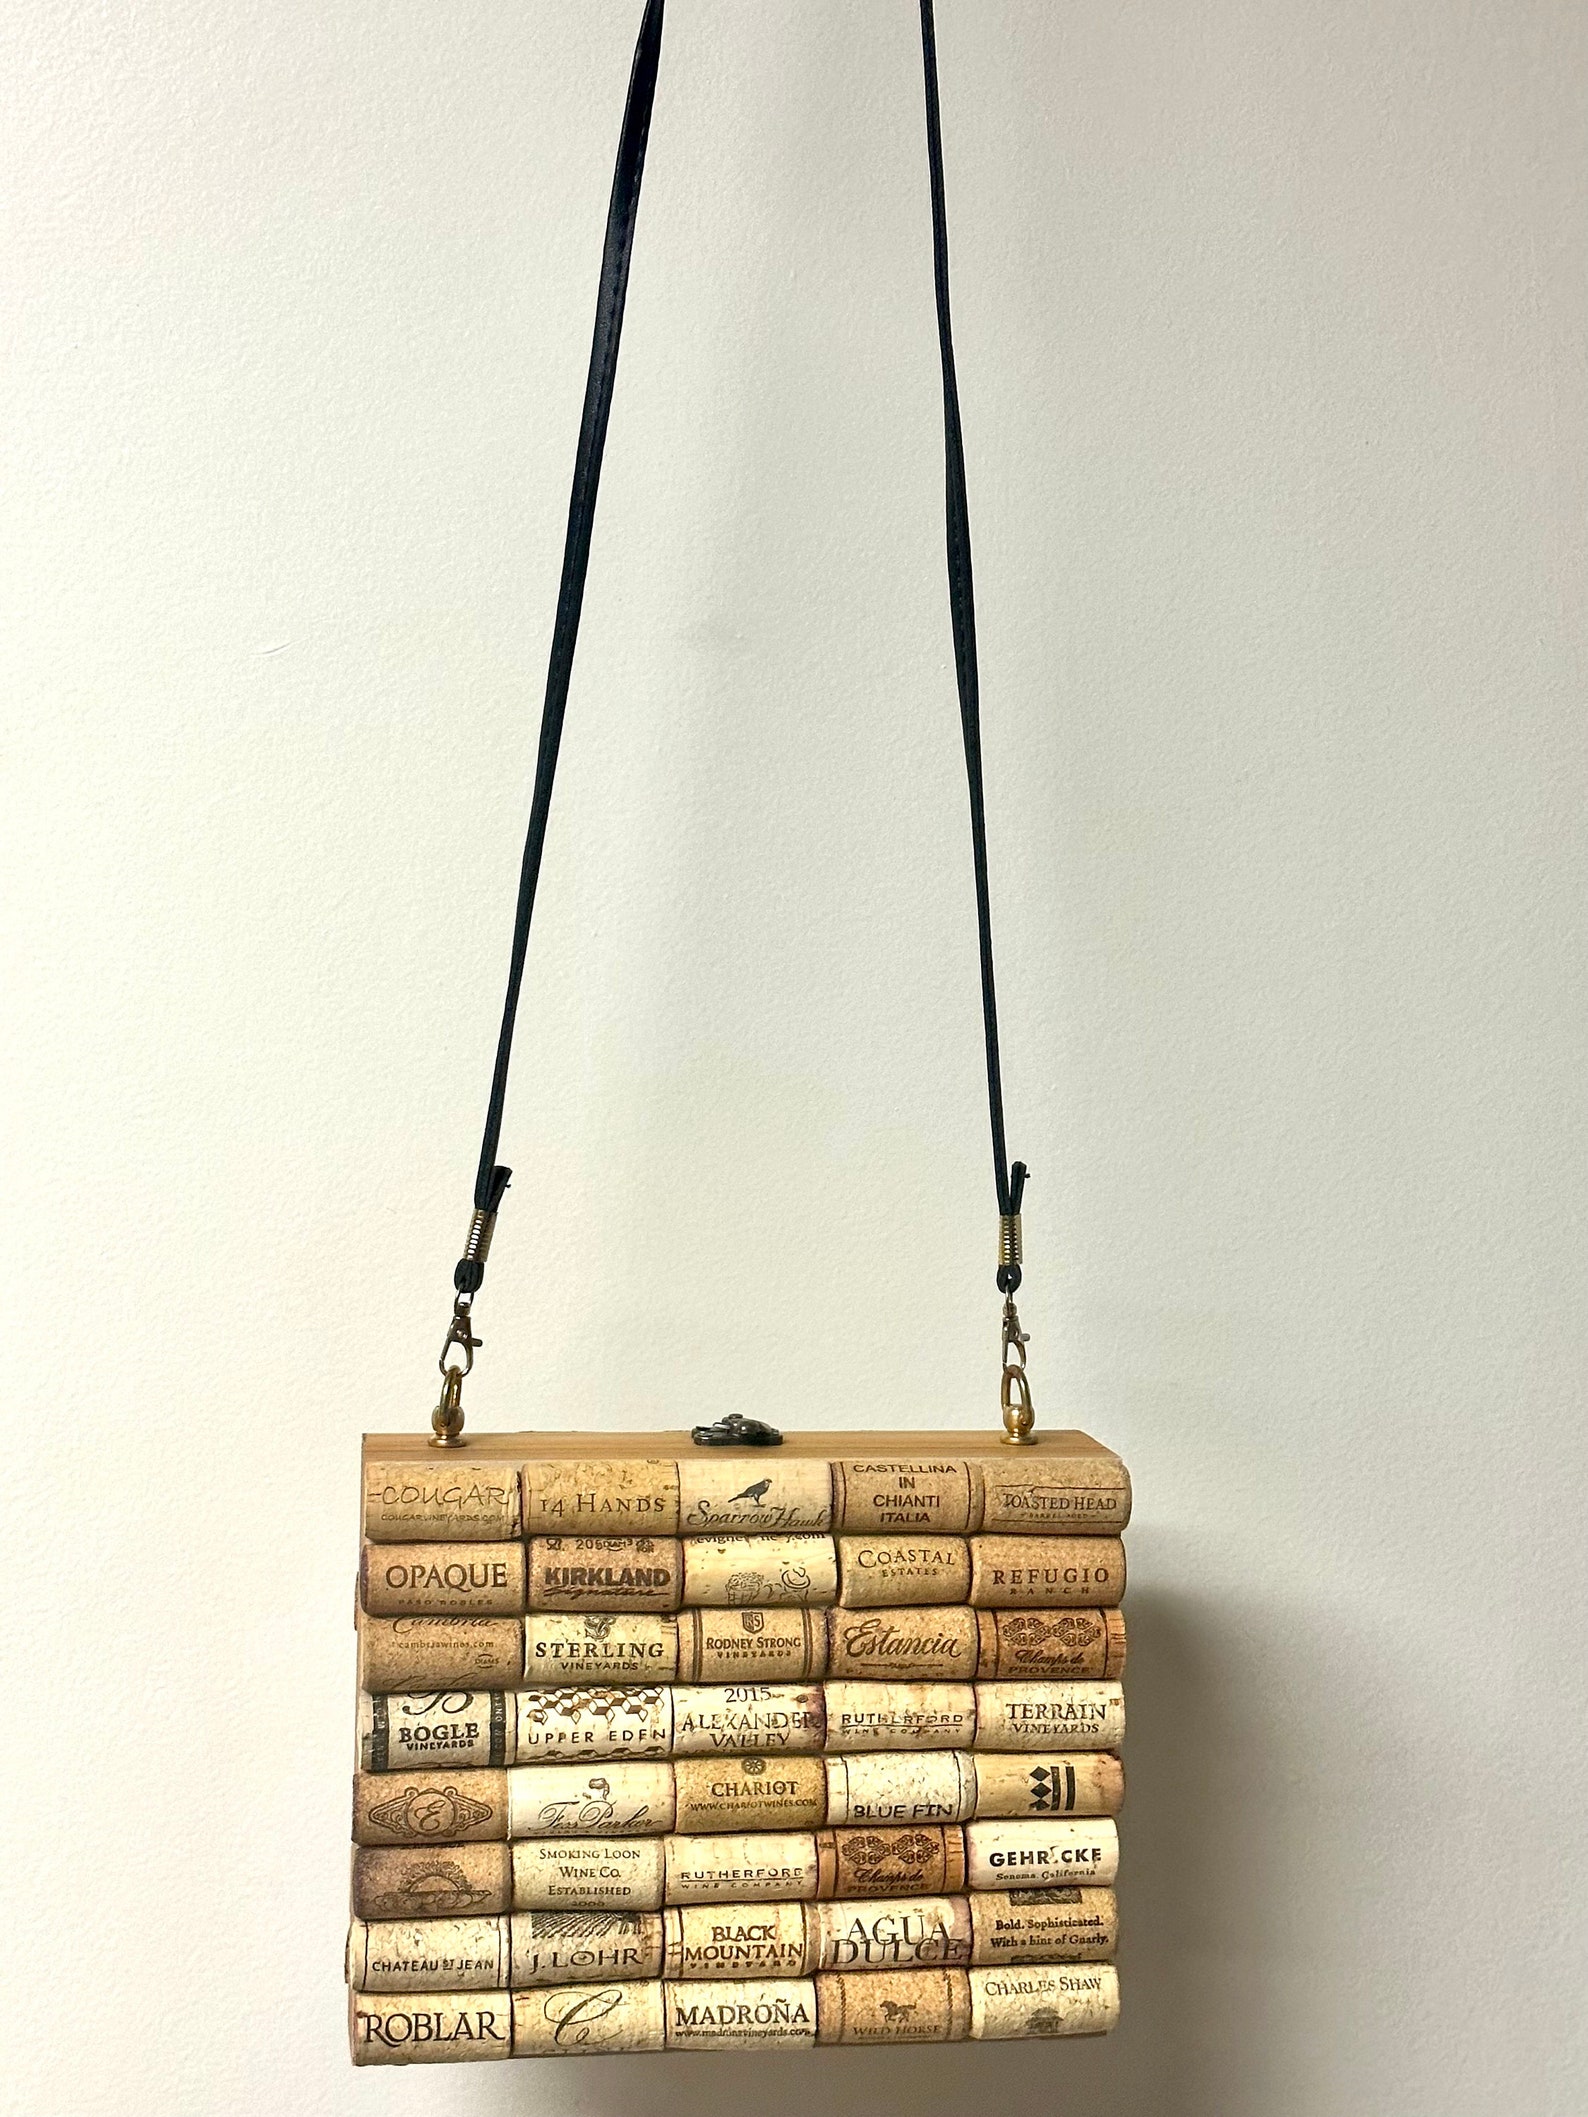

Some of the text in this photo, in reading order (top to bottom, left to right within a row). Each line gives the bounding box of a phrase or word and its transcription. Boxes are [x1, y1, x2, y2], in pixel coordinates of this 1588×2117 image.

[853, 1464, 957, 1474] CASTELLINA
[898, 1476, 915, 1489] IN
[382, 1484, 509, 1509] COUGAR
[873, 1494, 940, 1509] CHIANTI
[1003, 1492, 1117, 1510] TOASTED HEAD
[541, 1493, 666, 1517] 14 HANDS
[687, 1500, 828, 1528] Sparrow Hawk
[880, 1512, 931, 1523] ITALIA
[857, 1549, 955, 1568] COASTAL
[386, 1562, 508, 1591] OPAQUE
[545, 1567, 671, 1587] KIRKLAND
[882, 1567, 938, 1577] ESTATES
[993, 1567, 1109, 1585] REFUGIO
[1010, 1587, 1091, 1595] RANCH
[706, 1636, 801, 1650] RODNEY STRONG
[842, 1617, 962, 1658] Estancia
[535, 1642, 664, 1659] STERLING
[717, 1650, 791, 1659] VINEYARDS
[560, 1661, 638, 1671] VINEYARDS
[1008, 1666, 1090, 1674] PROVENCE
[724, 1686, 772, 1703] 2015
[1006, 1703, 1106, 1720] TERRAIN
[398, 1722, 479, 1743] BOGLE
[528, 1728, 666, 1745] UPPER EDEN
[1013, 1723, 1099, 1734] VINEYARDS
[406, 1739, 475, 1751] VINEYARDS
[710, 1732, 790, 1748] VALLEY
[711, 1781, 799, 1797] CHARIOT
[579, 1799, 662, 1829] Parker
[854, 1803, 953, 1819] BLUE FIN
[539, 1848, 641, 1859] SMOKING LOON
[559, 1866, 622, 1878] WINE CO.
[1041, 1868, 1096, 1880] California
[548, 1885, 631, 1896] ESTABLISHED
[731, 1880, 803, 1888] COMPANY
[846, 1914, 950, 1946] AGUA
[995, 1915, 1104, 1931] Bold. Sophisticated.
[711, 1925, 776, 1942] BLACK
[990, 1935, 1018, 1948] With
[1029, 1935, 1052, 1946] hint
[1054, 1934, 1067, 1945] of
[1069, 1932, 1109, 1946] Gnarly.
[685, 1943, 803, 1961] MOUNTAIN
[832, 1937, 965, 1965] DULCE
[372, 1960, 439, 1972] CHATEAU
[457, 1959, 494, 1970] JEAN
[689, 1960, 797, 1969] VINEYARD
[985, 1976, 1102, 1996] CHARLES SHAW
[364, 2011, 505, 2047] ROBLAR
